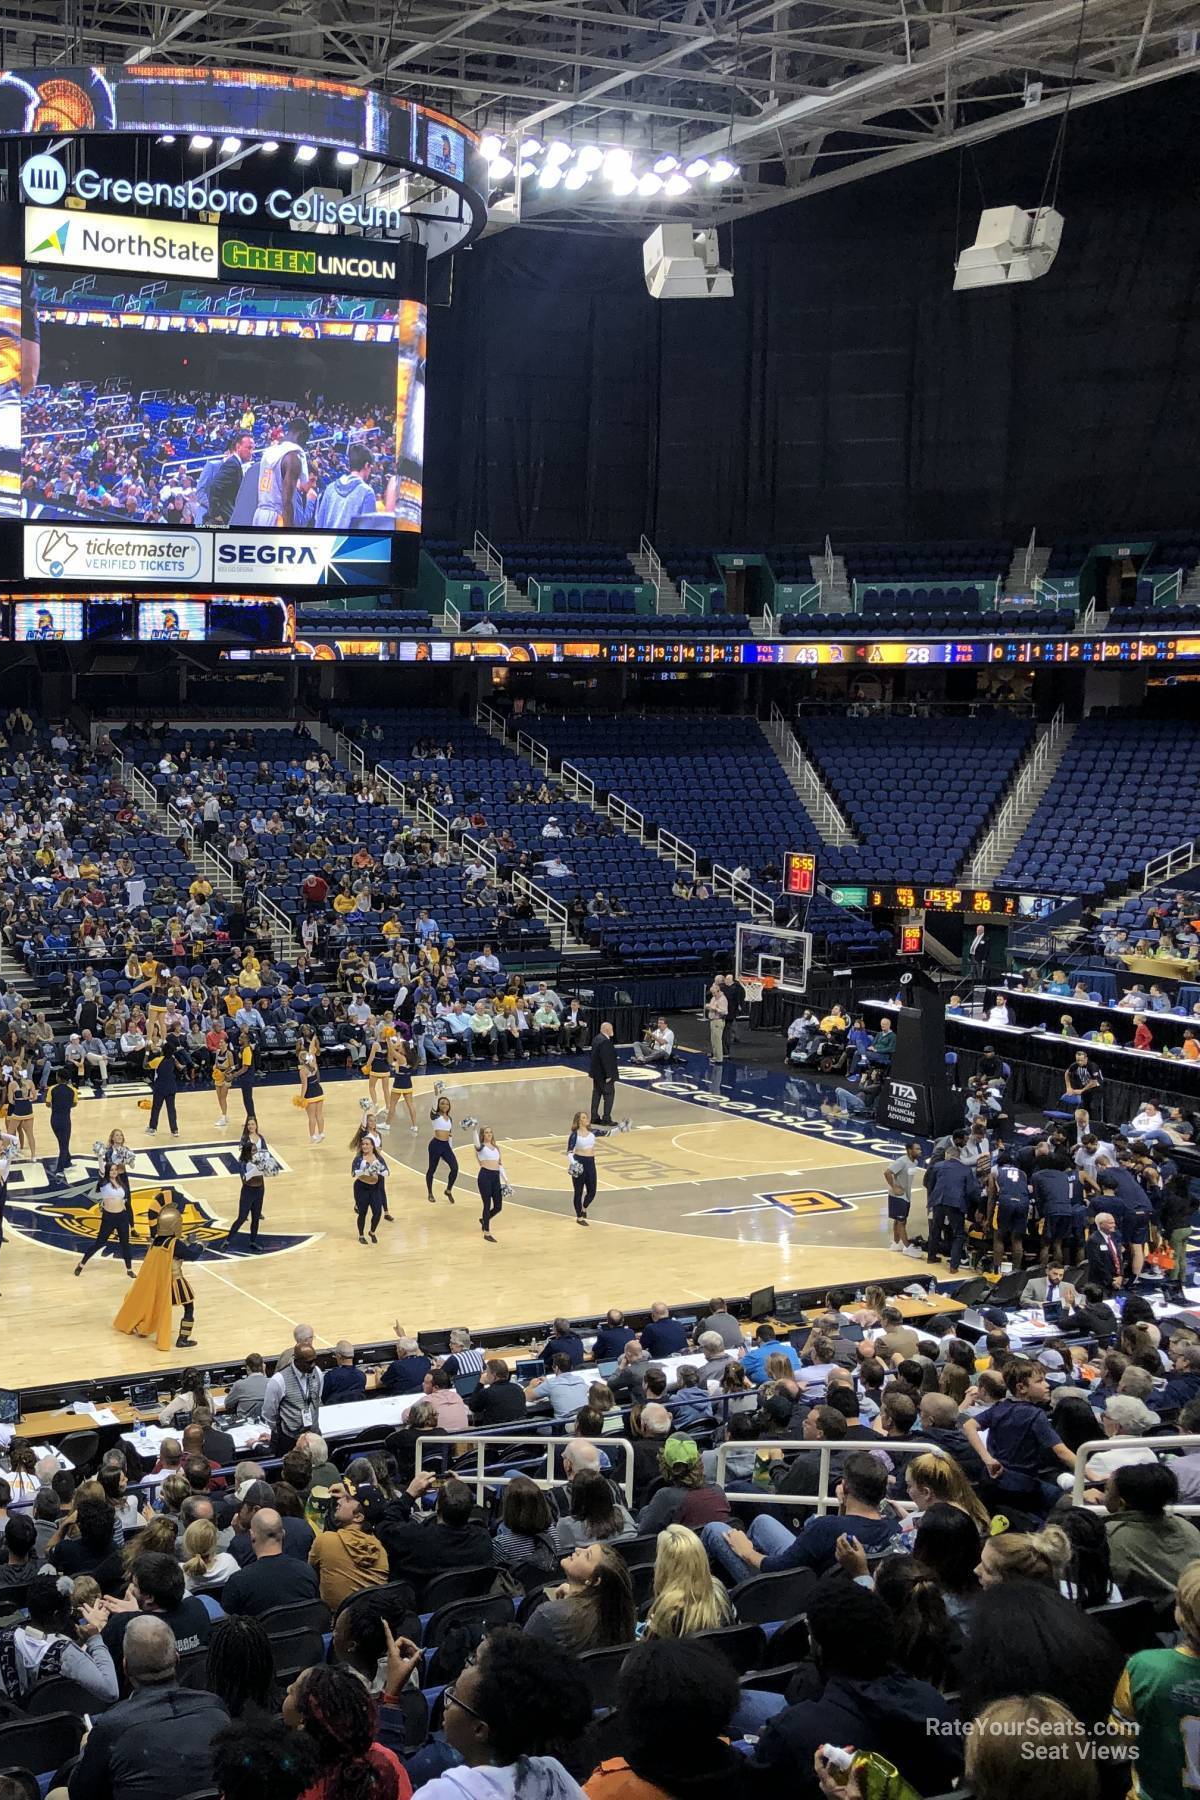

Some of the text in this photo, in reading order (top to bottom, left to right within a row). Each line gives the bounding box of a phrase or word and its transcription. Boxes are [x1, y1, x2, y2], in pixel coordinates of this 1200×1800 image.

[75, 169, 401, 229] Greensboro Coliseum
[83, 229, 214, 263] NorthState
[222, 240, 396, 279] GREEN LINCOLN
[218, 544, 317, 564] SEGRA
[85, 559, 184, 571] VERIFIED TICKETS
[26, 630, 64, 640] UNCG
[151, 630, 189, 640] UNCG
[602, 647, 607, 657] 1
[629, 647, 635, 657] 2
[654, 647, 664, 657] 13
[683, 647, 694, 657] 14
[714, 648, 724, 658] 21
[796, 648, 818, 663] 43
[906, 647, 930, 663] 28
[994, 647, 1003, 658] 0
[1033, 646, 1040, 656] 1
[1070, 645, 1079, 656] 2
[1105, 645, 1120, 656] 20
[1141, 645, 1156, 656] 50
[944, 654, 951, 662] 2
[792, 857, 813, 870] 15:55
[791, 870, 810, 890] 30
[874, 894, 881, 905] 3
[898, 895, 914, 907] 43
[929, 890, 960, 902] 15:55
[974, 900, 991, 911] 28
[1006, 902, 1014, 912] 2
[890, 1082, 917, 1100] TFA
[1007, 1170, 1019, 1182] 4
